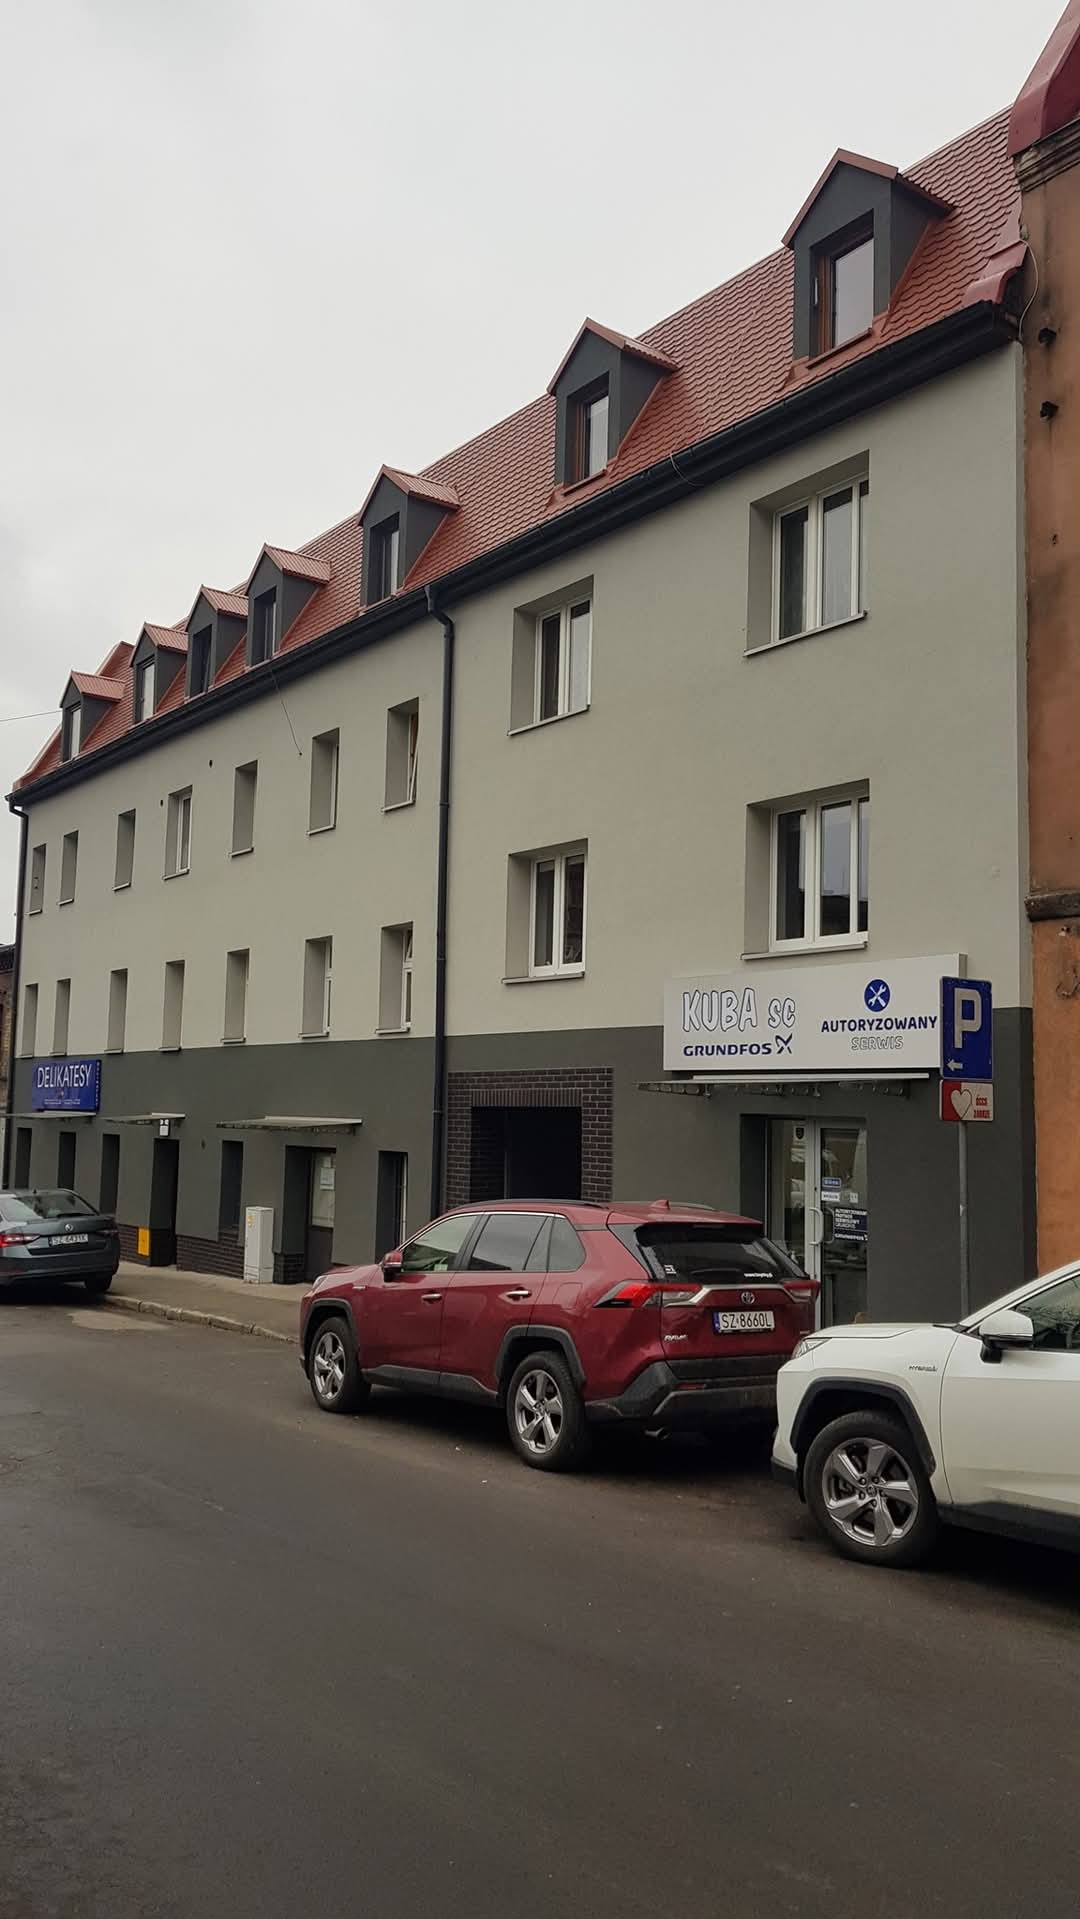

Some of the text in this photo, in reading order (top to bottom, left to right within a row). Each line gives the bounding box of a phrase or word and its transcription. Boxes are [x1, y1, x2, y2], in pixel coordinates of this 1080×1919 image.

[682, 987, 758, 1033] KUBA
[954, 988, 982, 1049] P
[821, 1015, 938, 1033] AUTORYZOWANY
[683, 1042, 772, 1057] GRUNDFOS
[851, 1035, 904, 1051] SERWIS
[37, 1064, 92, 1088] DELIKATESY
[721, 1311, 773, 1329] SZ 8660L
